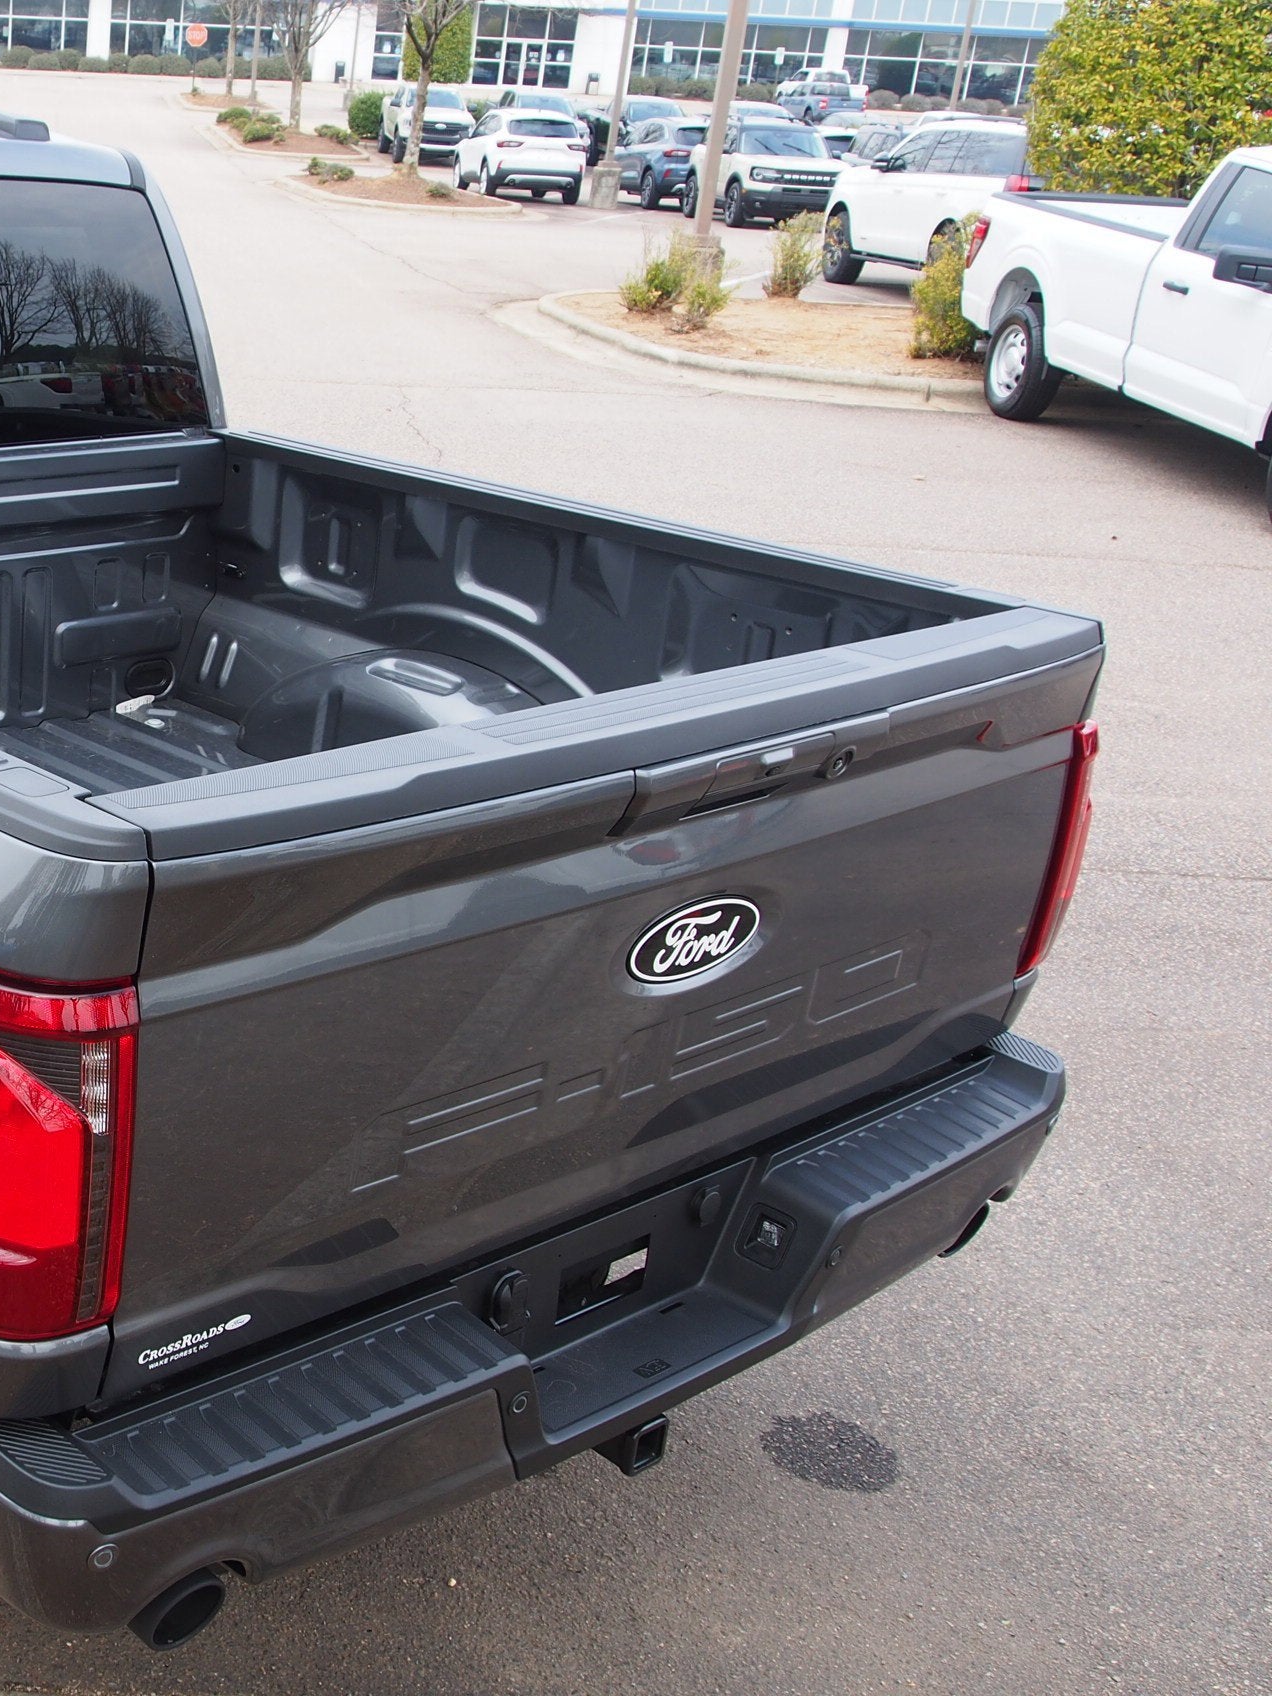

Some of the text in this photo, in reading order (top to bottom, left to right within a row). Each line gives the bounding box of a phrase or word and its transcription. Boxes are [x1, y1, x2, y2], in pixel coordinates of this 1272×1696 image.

[653, 910, 740, 973] Ford
[148, 1358, 169, 1370] WAKE
[198, 1342, 210, 1351] NC
